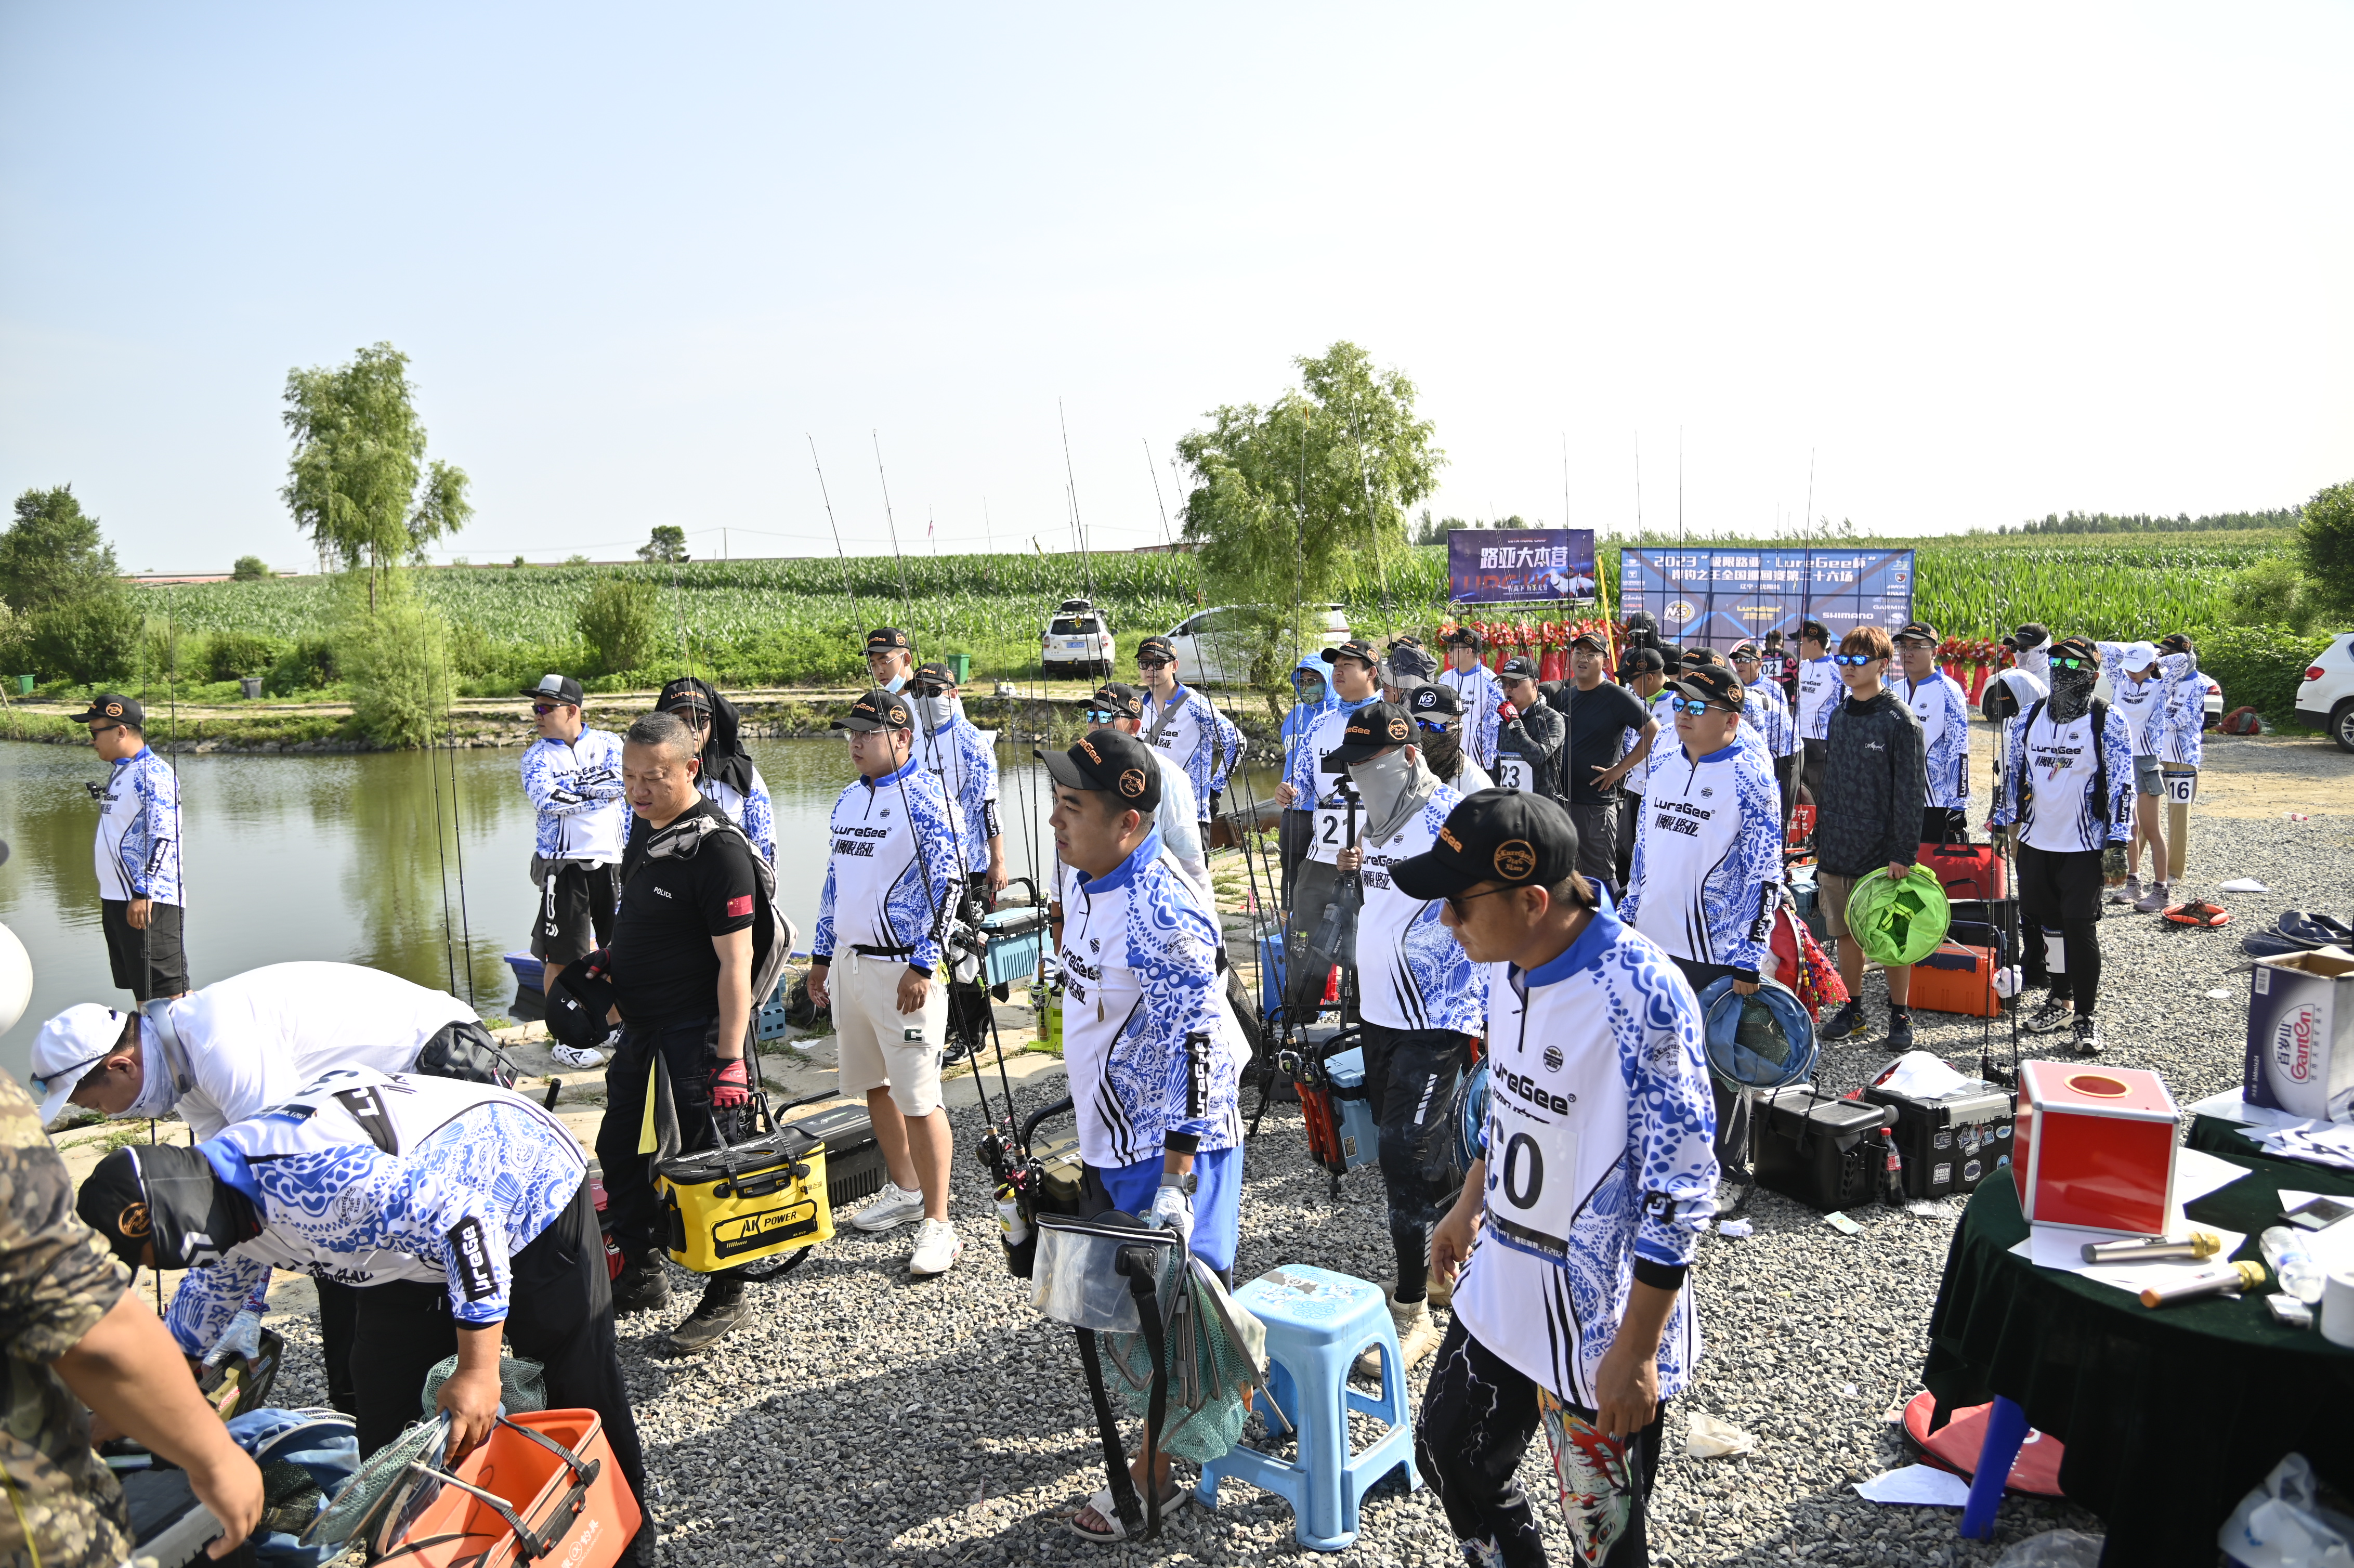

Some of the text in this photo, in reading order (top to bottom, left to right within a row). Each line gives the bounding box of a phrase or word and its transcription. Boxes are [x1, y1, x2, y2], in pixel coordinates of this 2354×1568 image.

[1480, 546, 1568, 569] 路亚大本营
[1654, 556, 1696, 567] 2023
[1672, 569, 1853, 582] 岸钓之王全国巡回赛第二十六场
[1761, 664, 1777, 675] 02
[671, 691, 704, 699] LureGee
[2031, 743, 2082, 755] LureGee
[1501, 765, 1521, 789] 23
[1959, 757, 1968, 796] LureGee
[2169, 781, 2190, 800] 16
[1654, 796, 1712, 820] LureGee
[834, 825, 887, 838] LureGee
[653, 886, 672, 899] POLICE
[1333, 939, 1342, 954] IMAGE
[2276, 1022, 2292, 1066] 百岁山
[1487, 1114, 1544, 1210] 03
[743, 1211, 797, 1234] AK POWER
